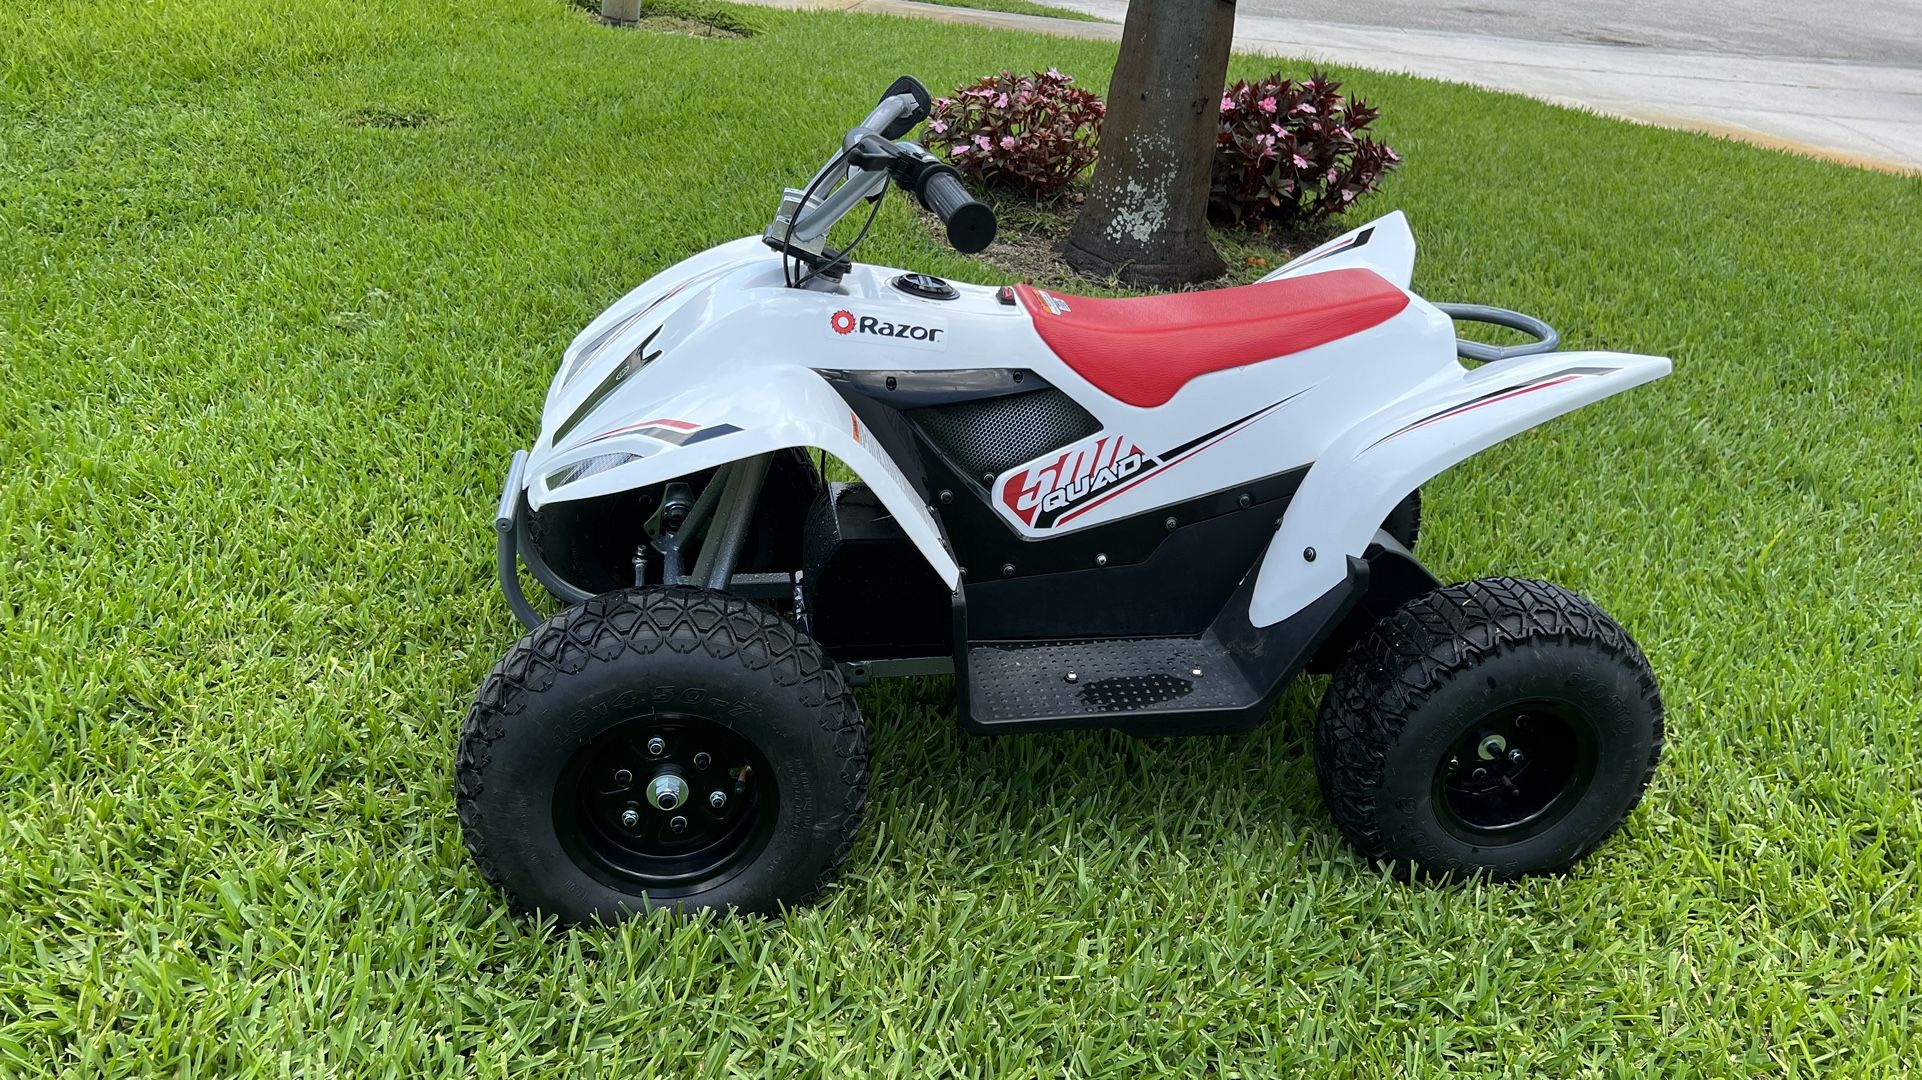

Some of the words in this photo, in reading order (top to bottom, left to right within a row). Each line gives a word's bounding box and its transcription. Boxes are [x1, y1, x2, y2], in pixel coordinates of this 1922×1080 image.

[859, 315, 944, 343] Razor
[1016, 434, 1136, 512] 500
[1042, 452, 1143, 513] QUAD
